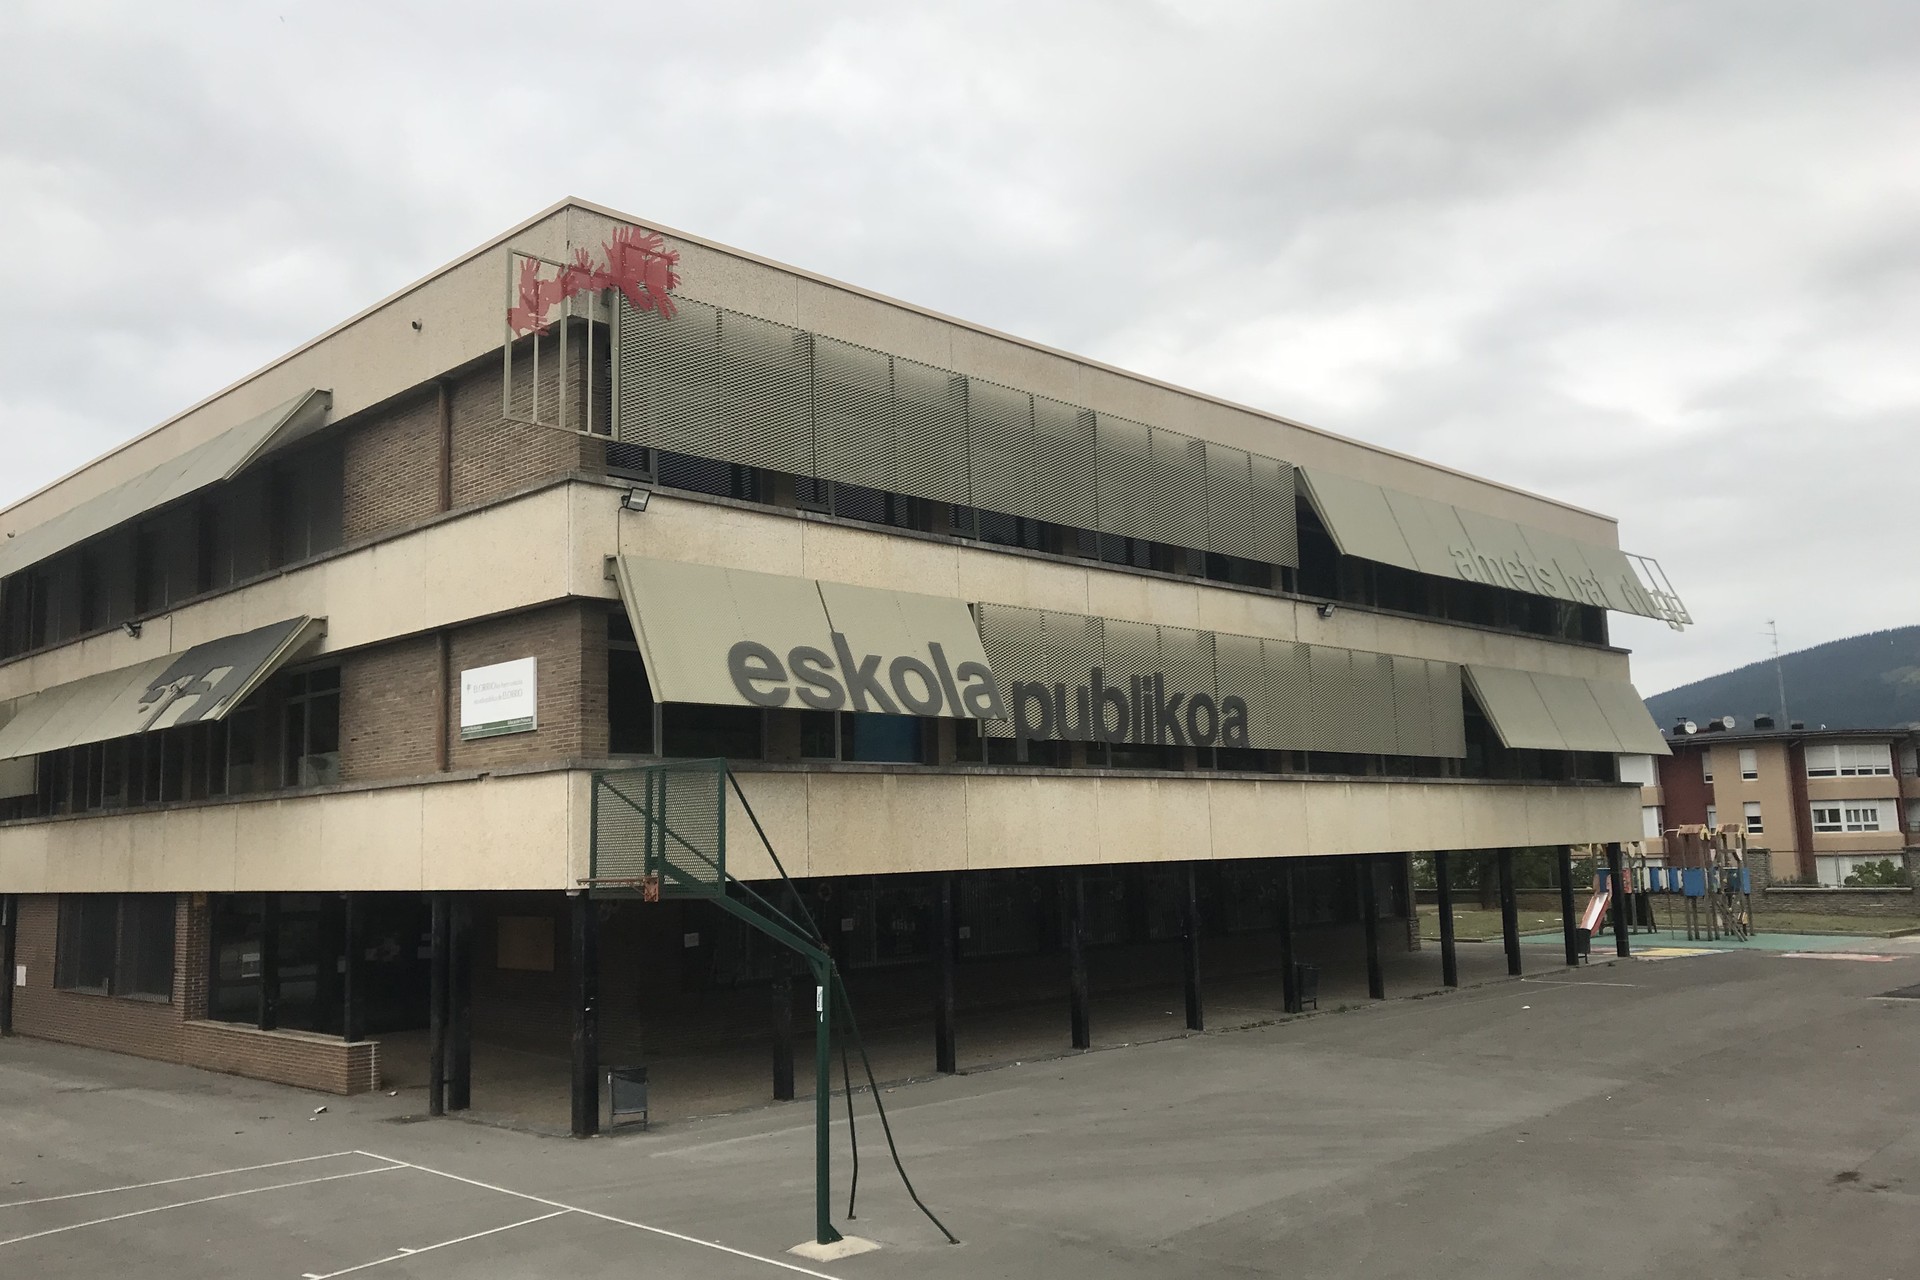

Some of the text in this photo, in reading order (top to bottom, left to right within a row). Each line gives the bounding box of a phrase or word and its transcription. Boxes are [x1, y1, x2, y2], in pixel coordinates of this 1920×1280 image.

[1448, 544, 1557, 598] amets
[1552, 558, 1615, 609] bat
[728, 632, 1249, 761] eskola publikoa
